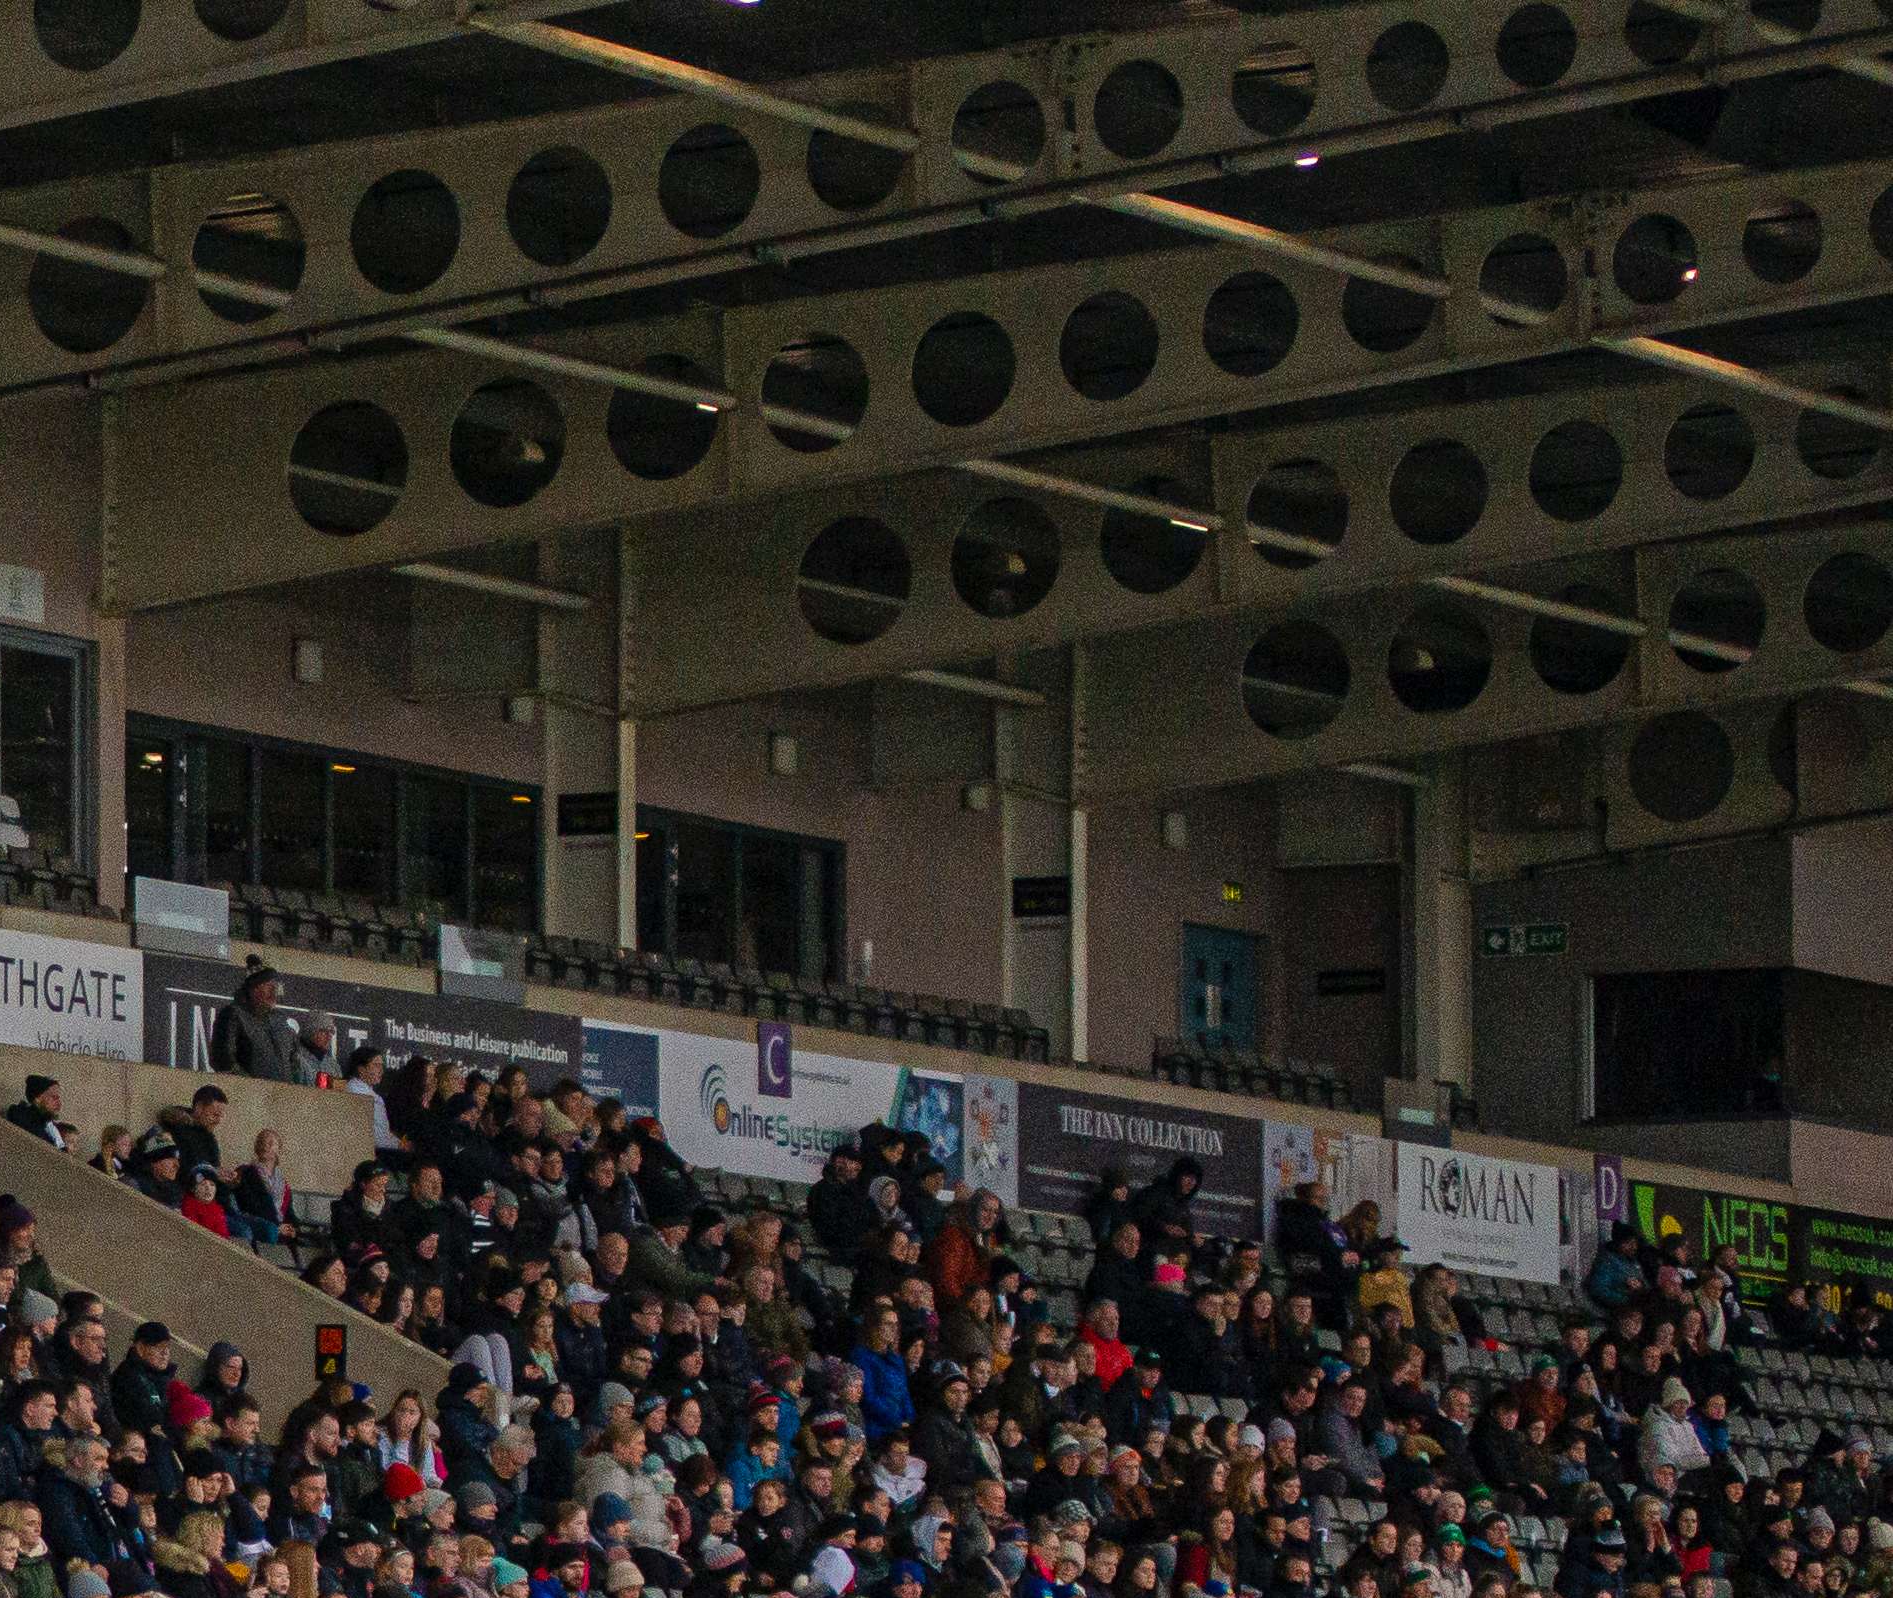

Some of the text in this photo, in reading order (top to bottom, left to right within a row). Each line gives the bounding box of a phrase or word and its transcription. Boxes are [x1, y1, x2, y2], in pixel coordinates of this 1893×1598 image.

[1529, 932, 1564, 946] EXIT
[385, 1018, 404, 1039] The
[407, 1021, 452, 1047] Business
[454, 1029, 473, 1049] and
[475, 1031, 510, 1055] Leisure
[511, 1037, 568, 1065] publication
[385, 1048, 401, 1068] for
[766, 1035, 785, 1084] C
[1060, 1104, 1224, 1157] THE INN COLLECTION
[1420, 1156, 1535, 1226] ROMAN
[1601, 1166, 1618, 1210] D
[1702, 1197, 1789, 1272] NECS
